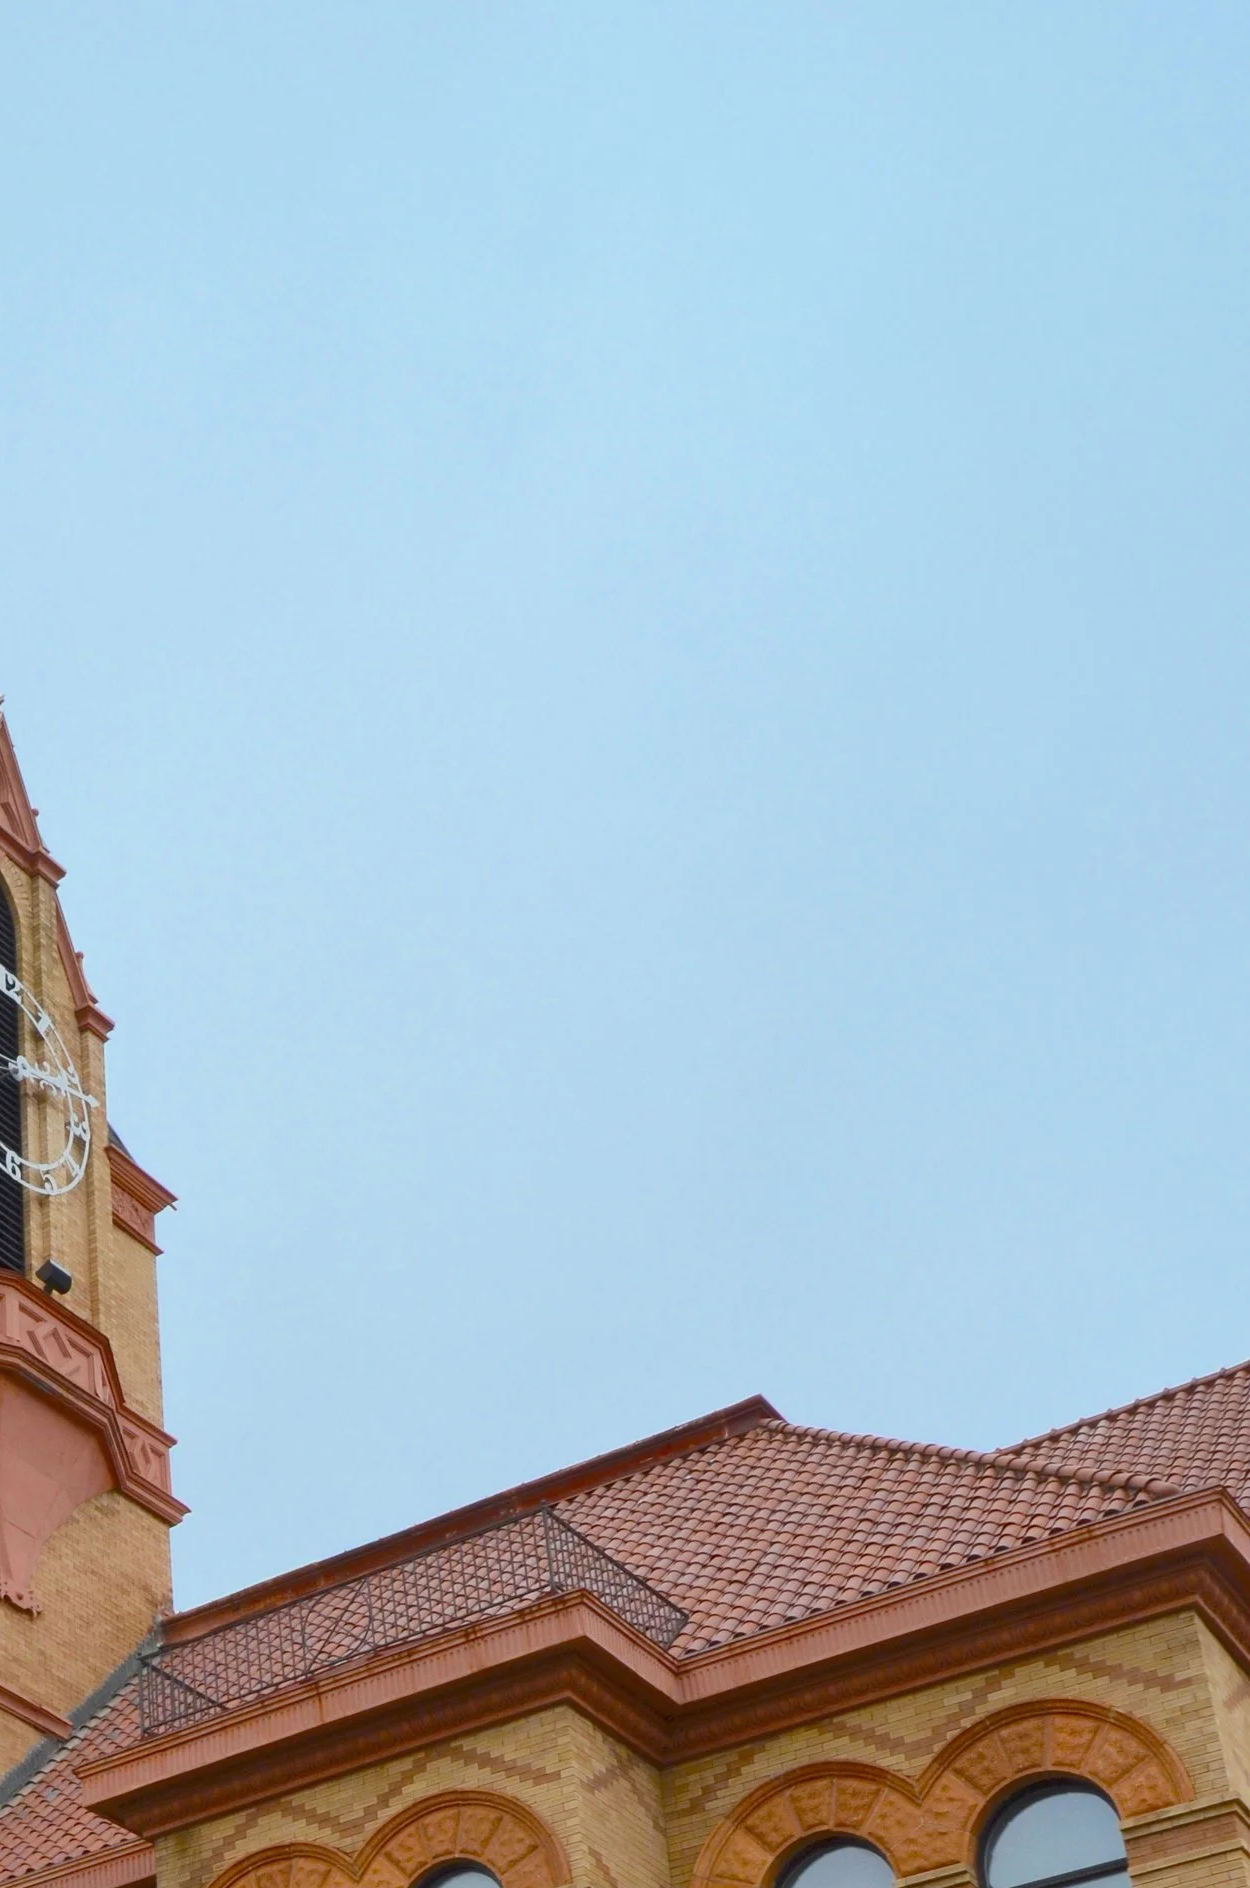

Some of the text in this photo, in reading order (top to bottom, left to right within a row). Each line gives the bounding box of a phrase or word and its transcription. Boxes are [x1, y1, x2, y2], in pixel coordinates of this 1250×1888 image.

[66, 1112, 91, 1143] 3
[5, 1151, 22, 1181] 6
[39, 1167, 58, 1194] 5
